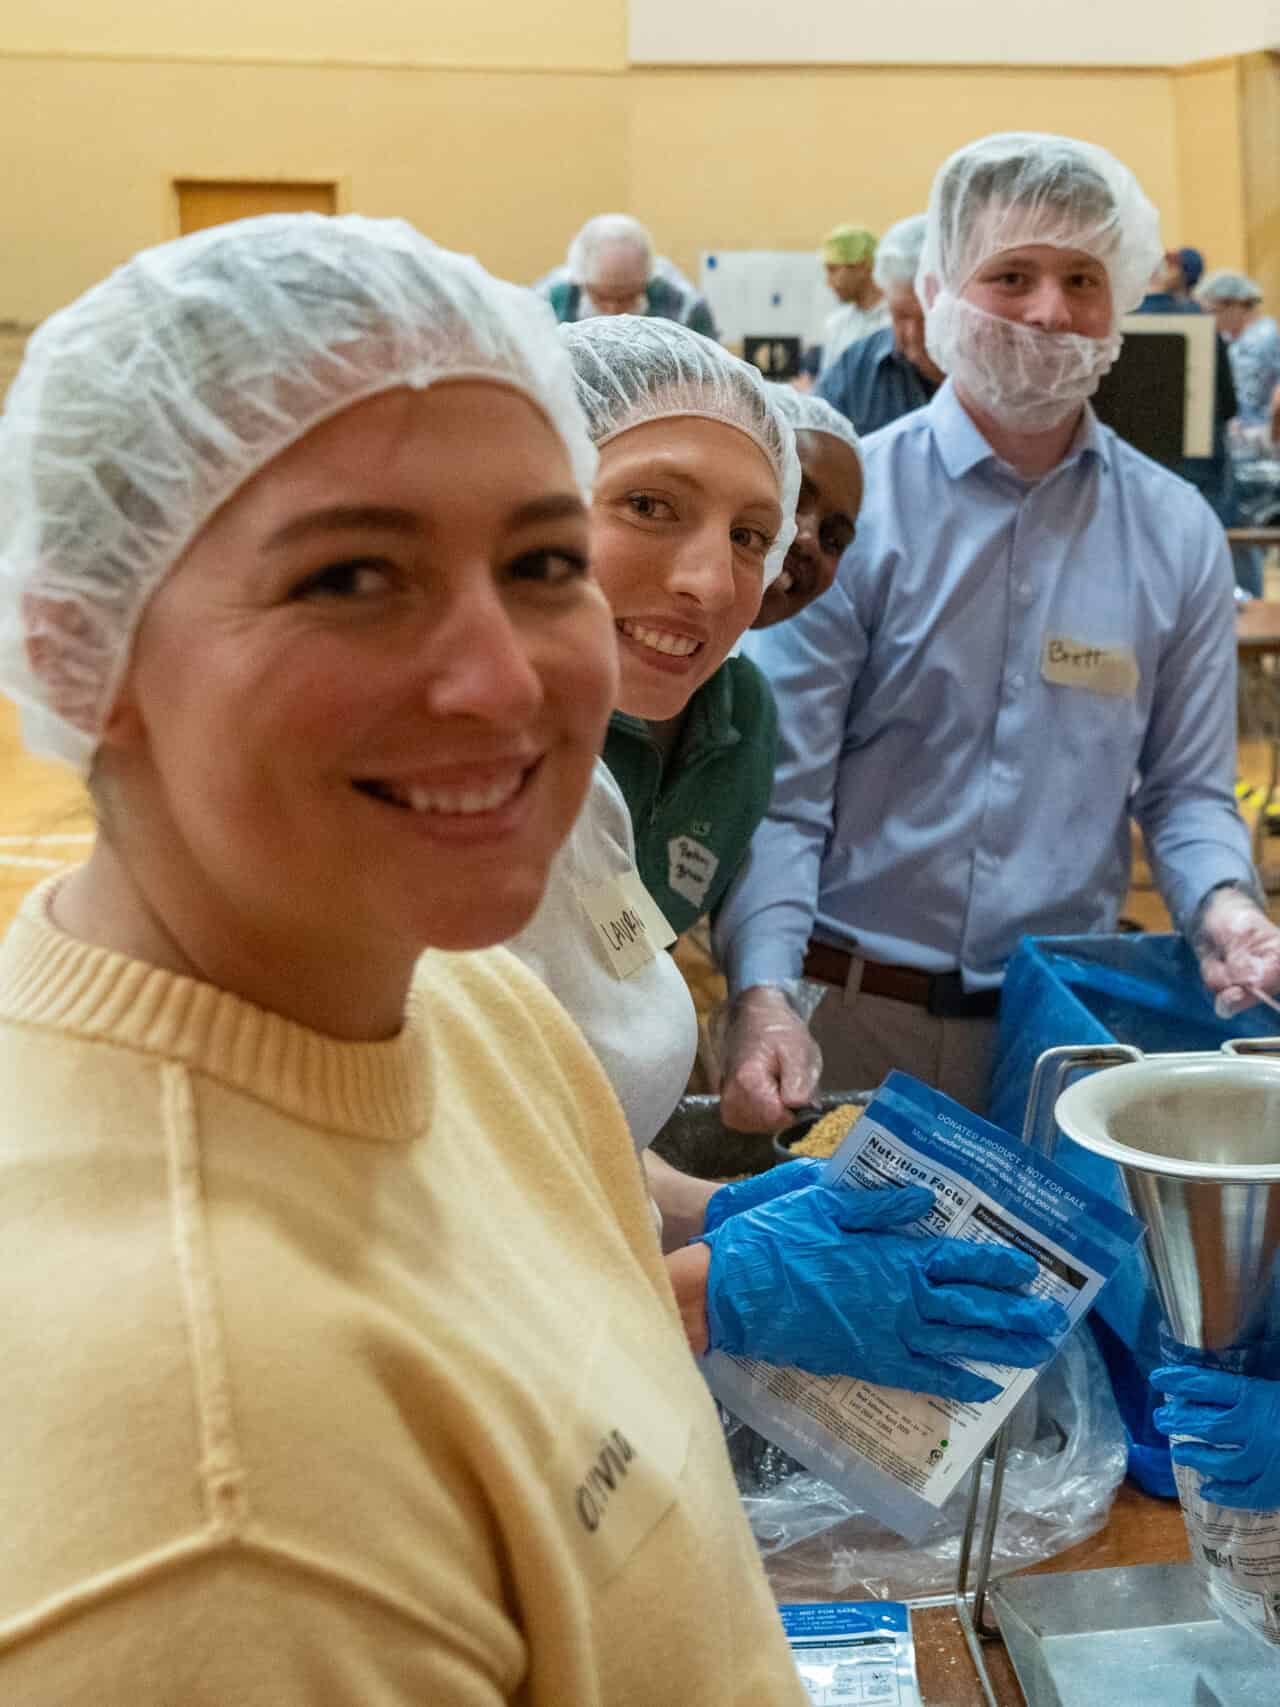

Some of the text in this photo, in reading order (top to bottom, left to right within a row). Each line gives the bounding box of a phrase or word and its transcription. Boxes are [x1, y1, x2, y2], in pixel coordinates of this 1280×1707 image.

[868, 1136, 927, 1180] Nutrition
[929, 1176, 964, 1206] Facts
[936, 1112, 979, 1141] DONATED
[979, 1136, 1021, 1164] PRODUCT
[1025, 1165, 1044, 1182] NOT
[1044, 1179, 1063, 1194] FOR
[1063, 1190, 1088, 1211] SALE
[924, 1210, 946, 1232] 212
